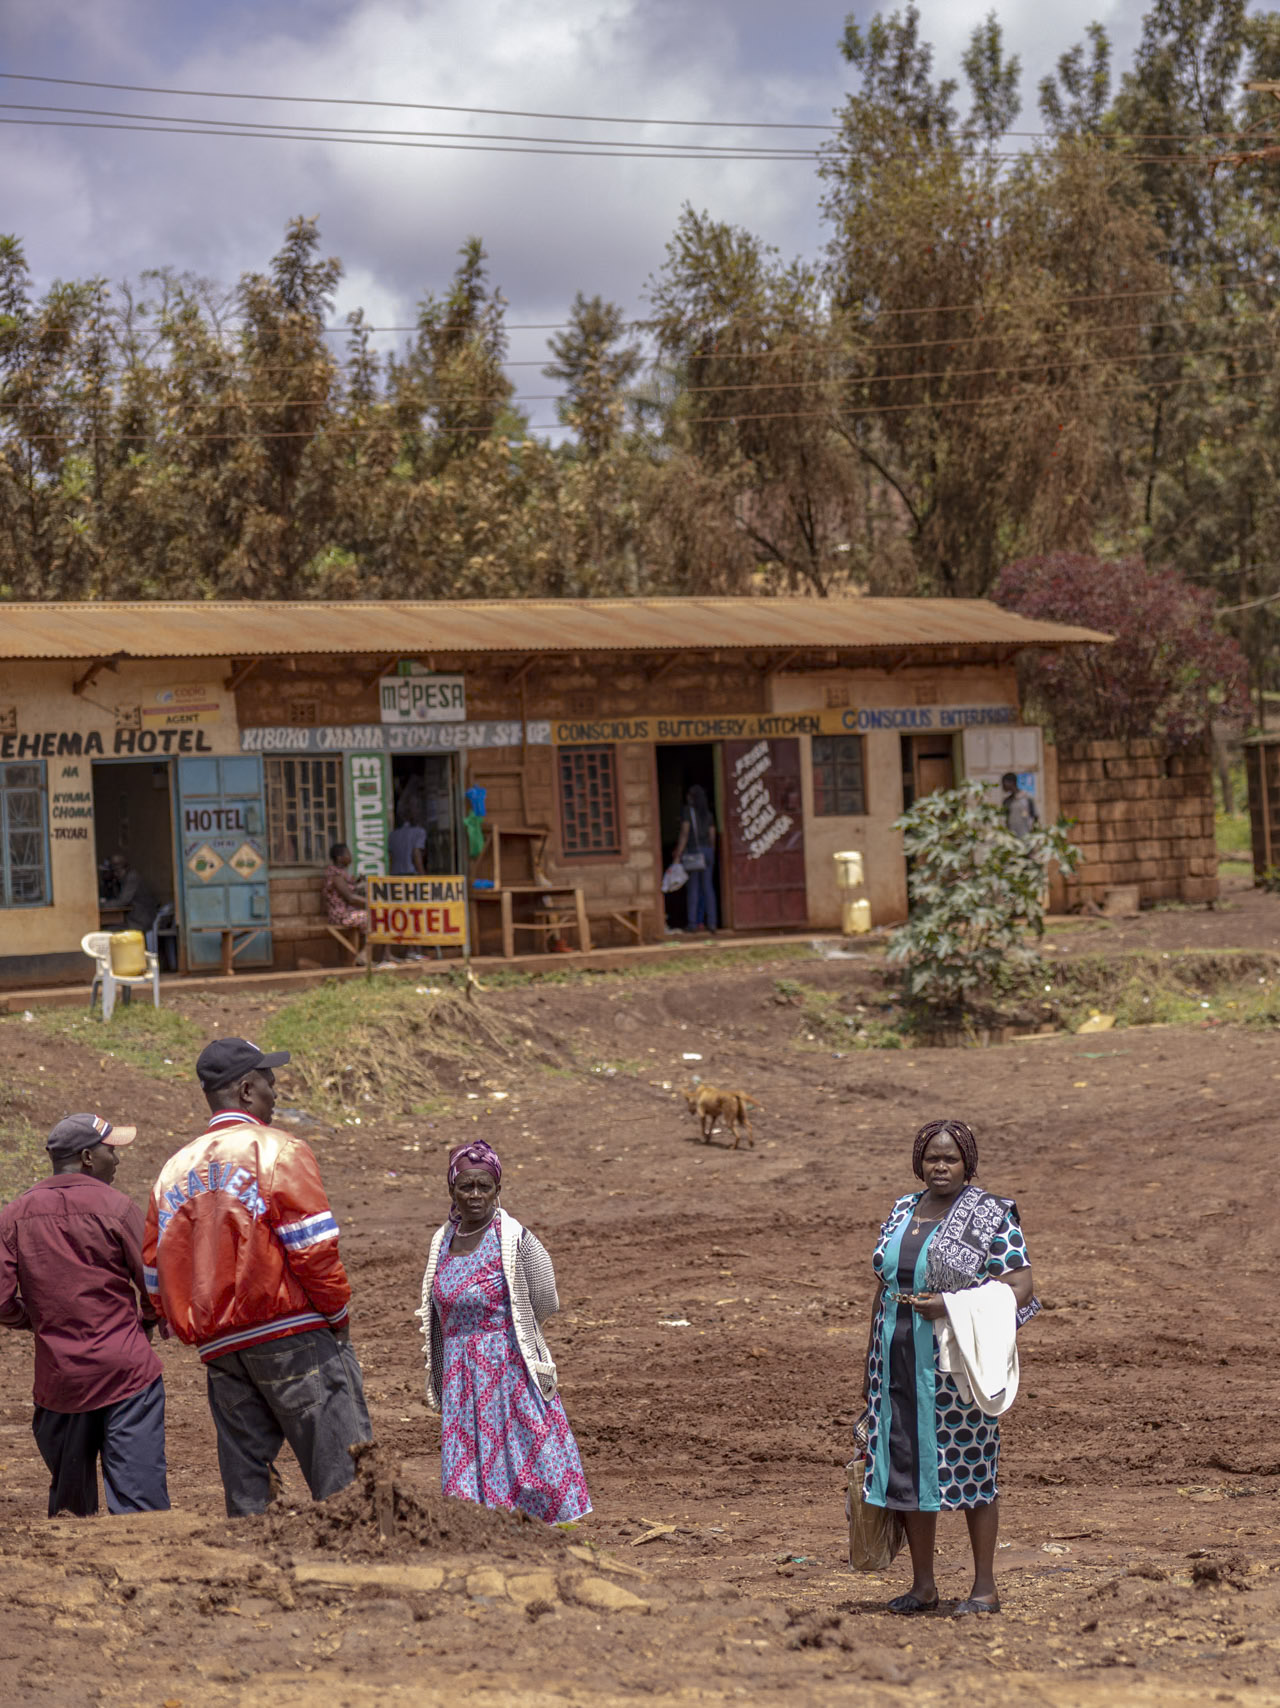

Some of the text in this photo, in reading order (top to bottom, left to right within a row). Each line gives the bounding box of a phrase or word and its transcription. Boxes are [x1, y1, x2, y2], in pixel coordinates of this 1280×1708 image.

[166, 713, 200, 725] AGENT
[842, 708, 932, 729] CONSCIOUS
[557, 720, 649, 742] CONSCIOUS
[658, 718, 747, 738] BUTCHERY
[114, 729, 212, 753] HOTEL
[53, 792, 91, 804] NYAMA
[52, 806, 93, 820] CHOMA
[185, 809, 245, 832] HOTEL
[372, 881, 465, 902] NEHEMAH
[370, 907, 461, 934] HOTEL
